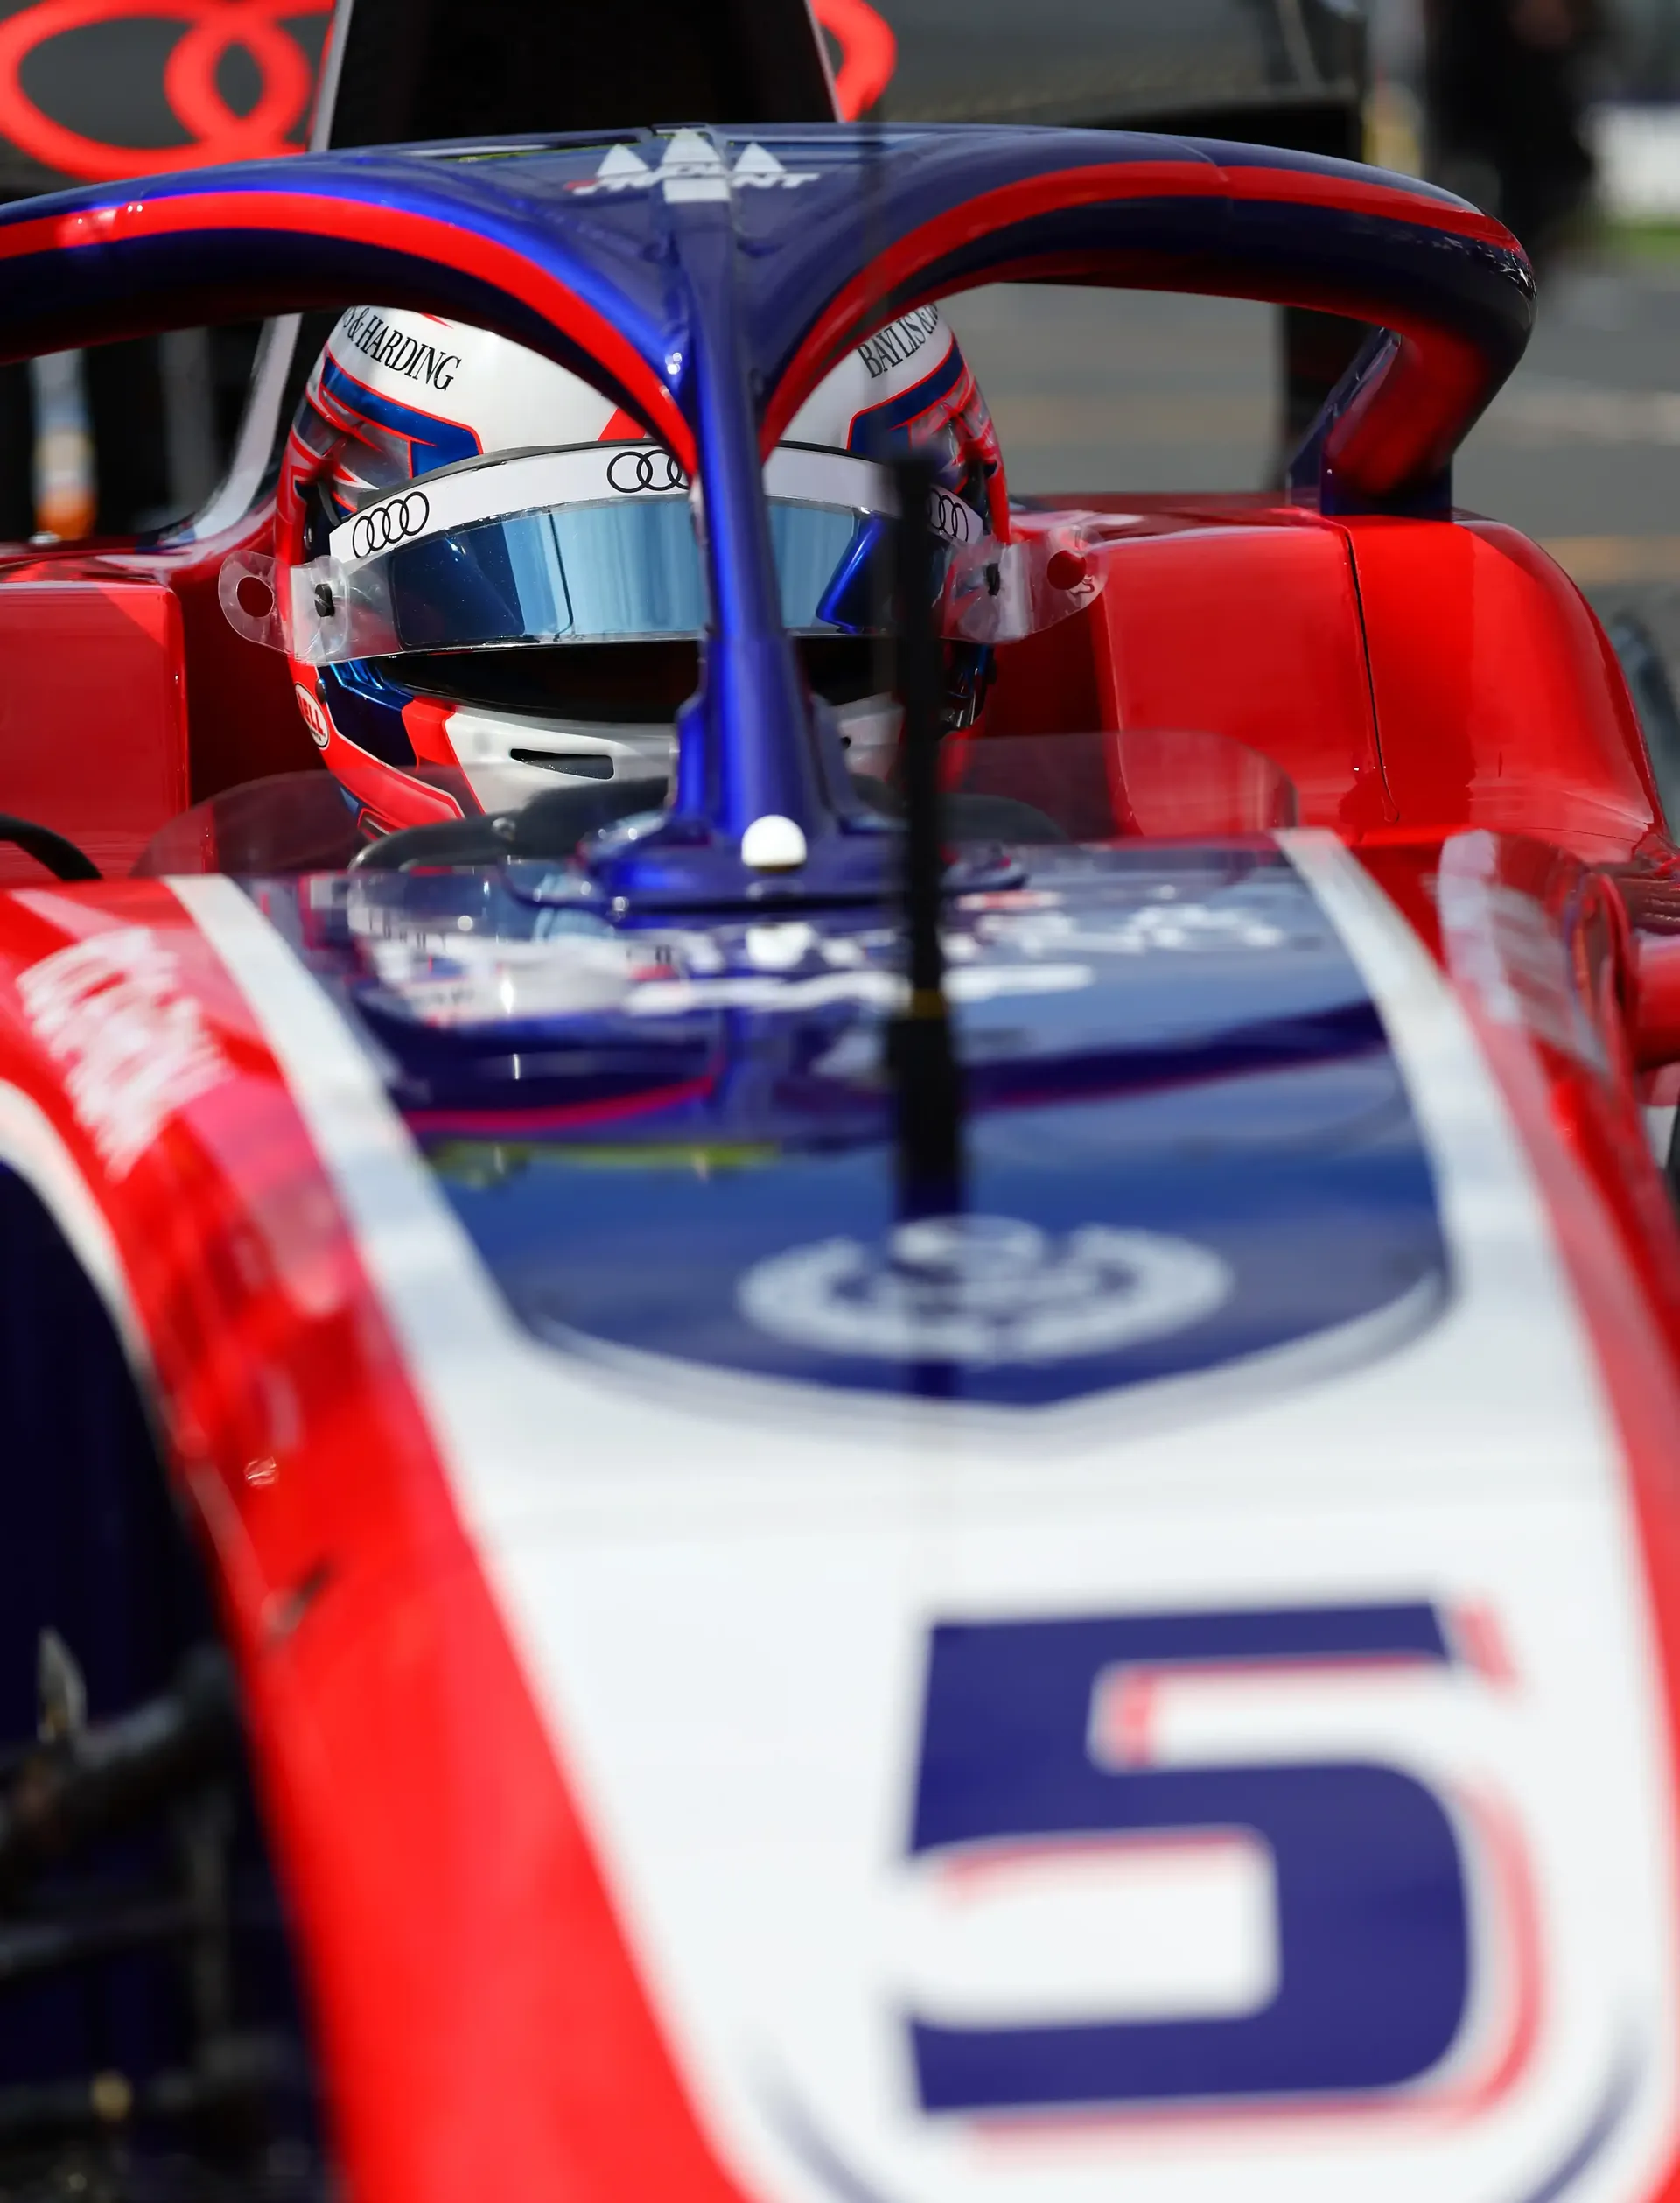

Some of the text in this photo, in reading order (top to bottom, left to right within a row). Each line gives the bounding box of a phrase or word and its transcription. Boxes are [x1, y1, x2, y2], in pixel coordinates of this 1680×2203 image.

[346, 306, 462, 391] & HARDING
[858, 314, 927, 379] BAYLIS
[906, 1600, 1479, 2118] 5
